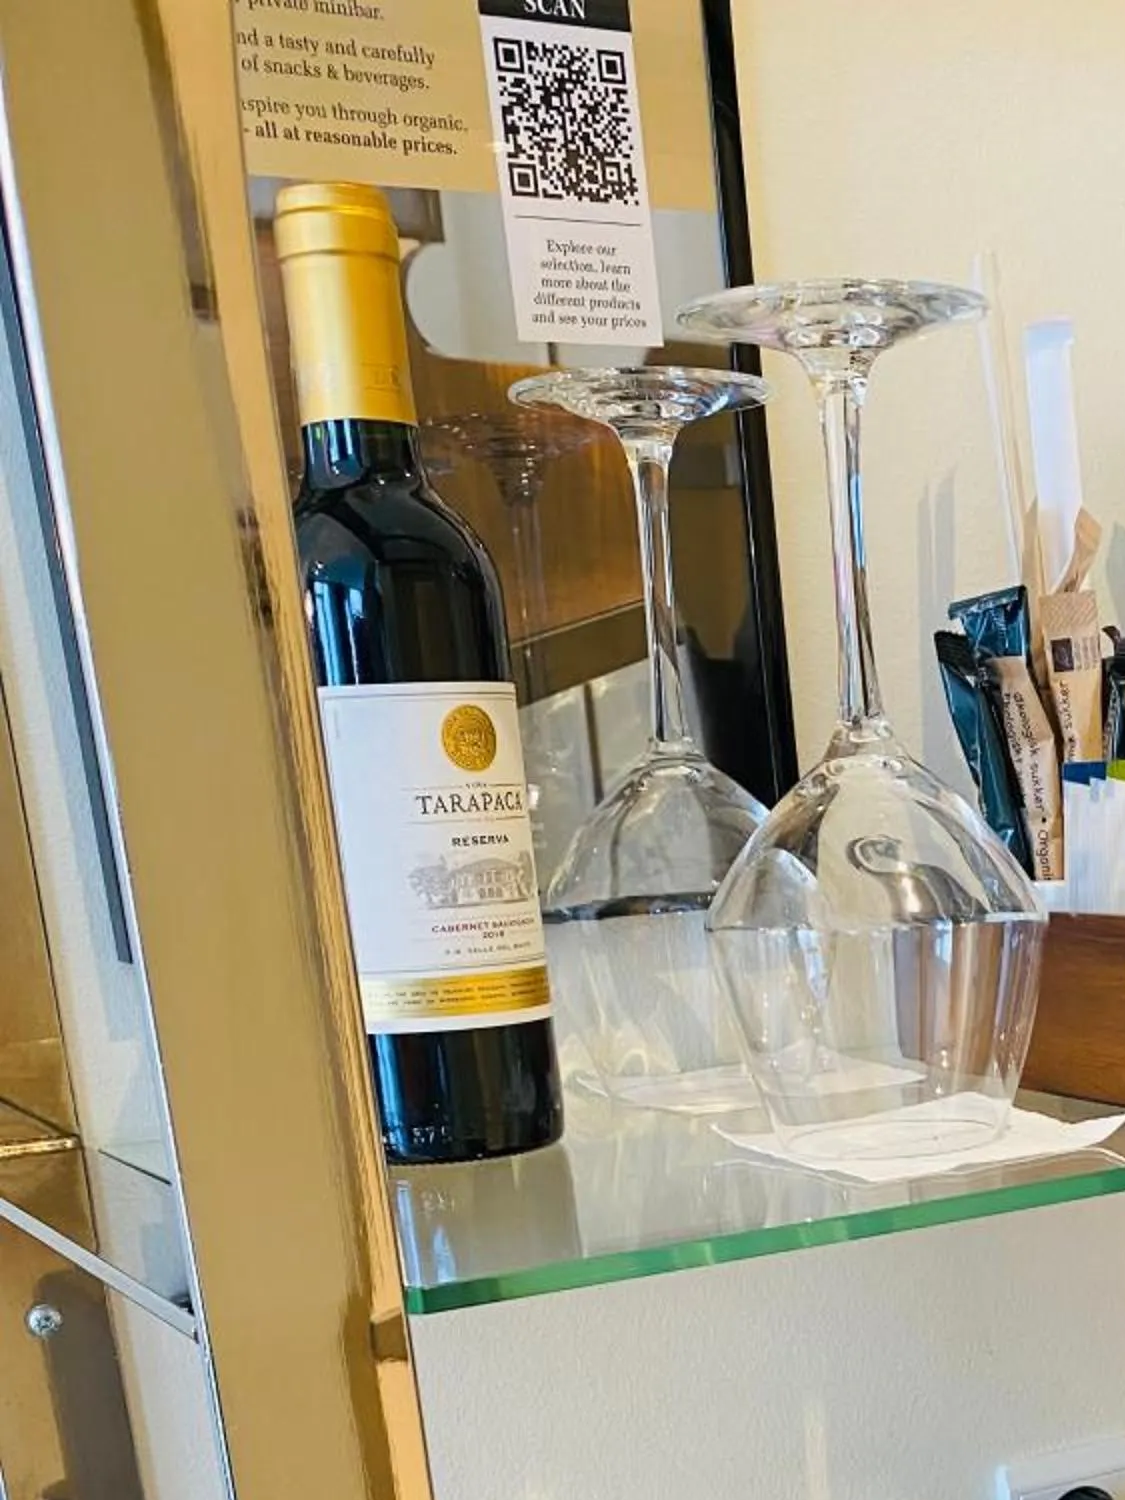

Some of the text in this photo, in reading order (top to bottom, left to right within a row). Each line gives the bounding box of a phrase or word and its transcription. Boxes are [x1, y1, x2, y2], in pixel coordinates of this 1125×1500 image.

[314, 0, 384, 20] minibar.
[523, 0, 586, 19] SCAN
[265, 34, 273, 47] a
[279, 33, 320, 57] tasty
[325, 38, 355, 56] and
[361, 44, 435, 70] carefully
[241, 54, 429, 92] of snacks & beverages.
[294, 103, 326, 121] you
[332, 102, 398, 127] through
[255, 120, 277, 139] all
[283, 124, 300, 141] at
[305, 127, 397, 150] reasonable
[402, 138, 457, 156] prices.
[546, 240, 617, 257] Explore our
[601, 261, 631, 275] learn
[541, 279, 630, 292] more about the
[533, 293, 640, 311] different products
[532, 310, 647, 330] and see your prices
[451, 834, 510, 847] RESERVA
